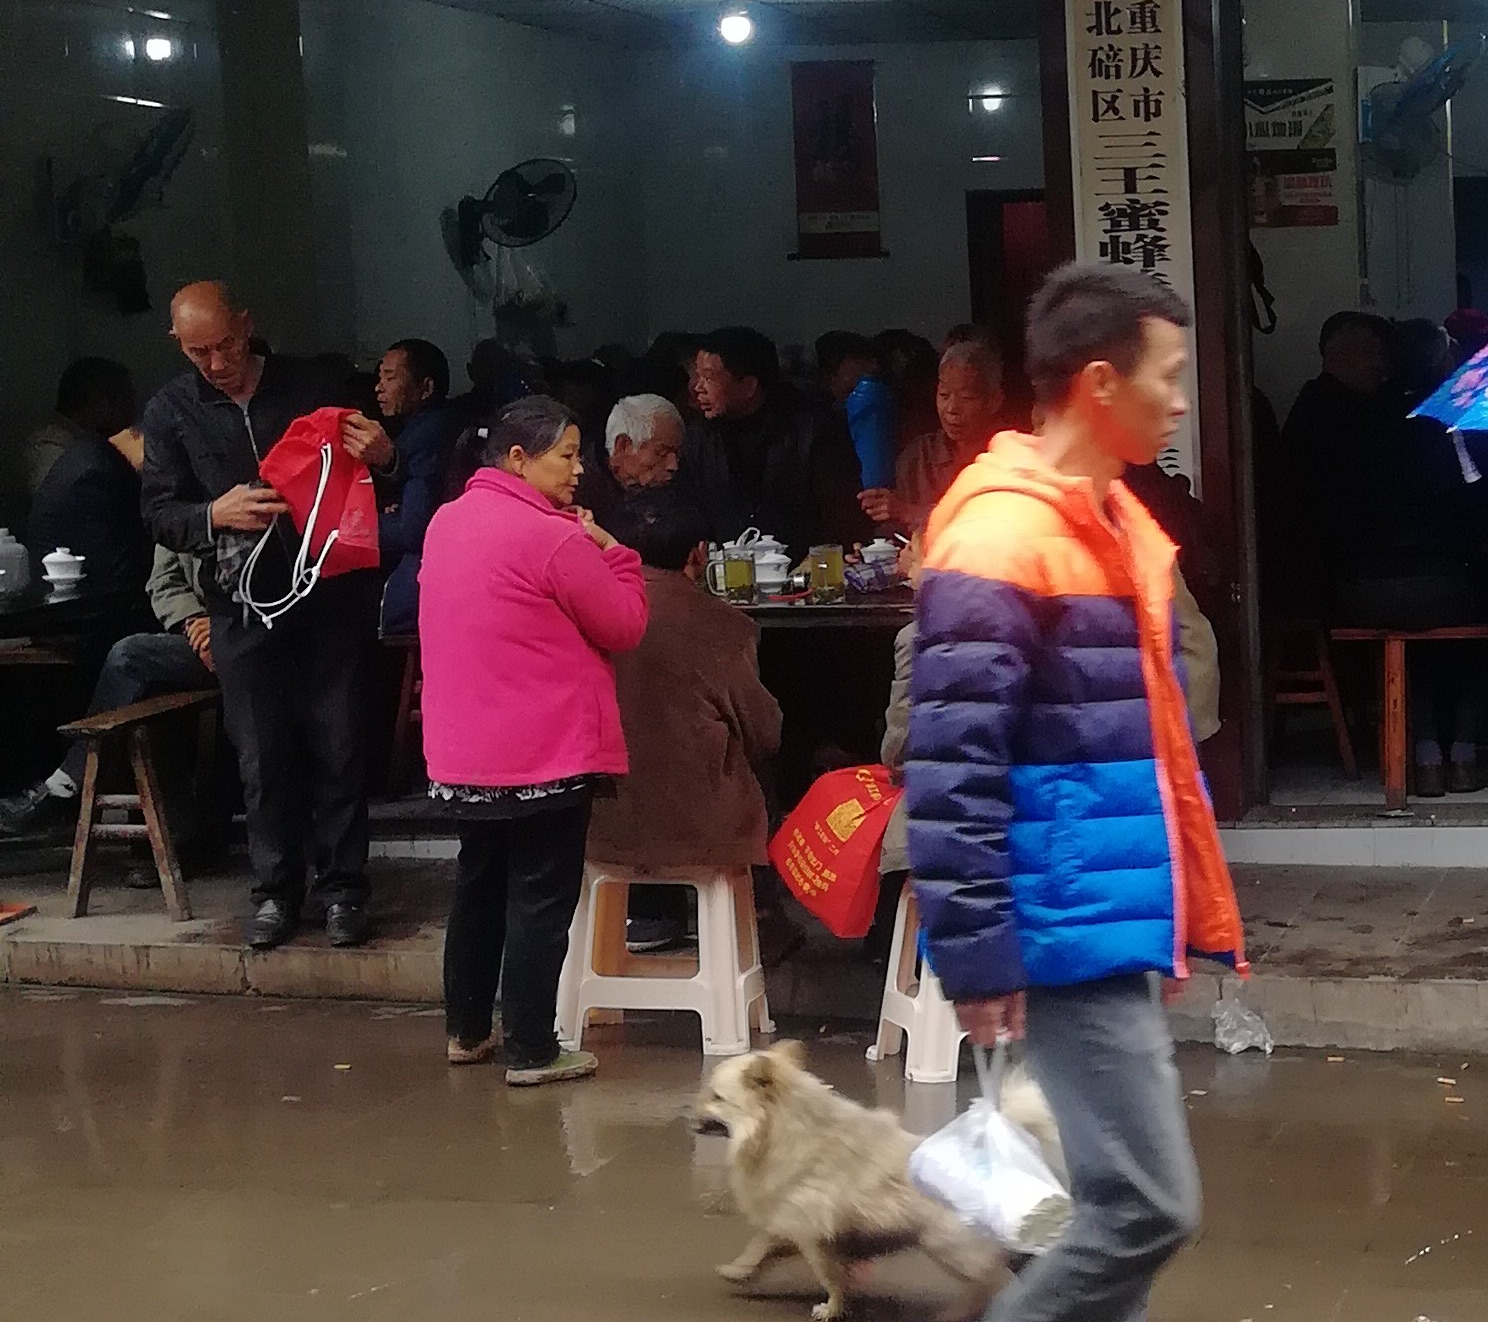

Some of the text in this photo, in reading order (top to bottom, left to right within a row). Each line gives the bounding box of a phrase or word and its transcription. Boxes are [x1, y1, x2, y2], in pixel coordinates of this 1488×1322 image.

[1085, 0, 1125, 122] 北碚区
[1093, 131, 1172, 285] 三王蜜蜂
